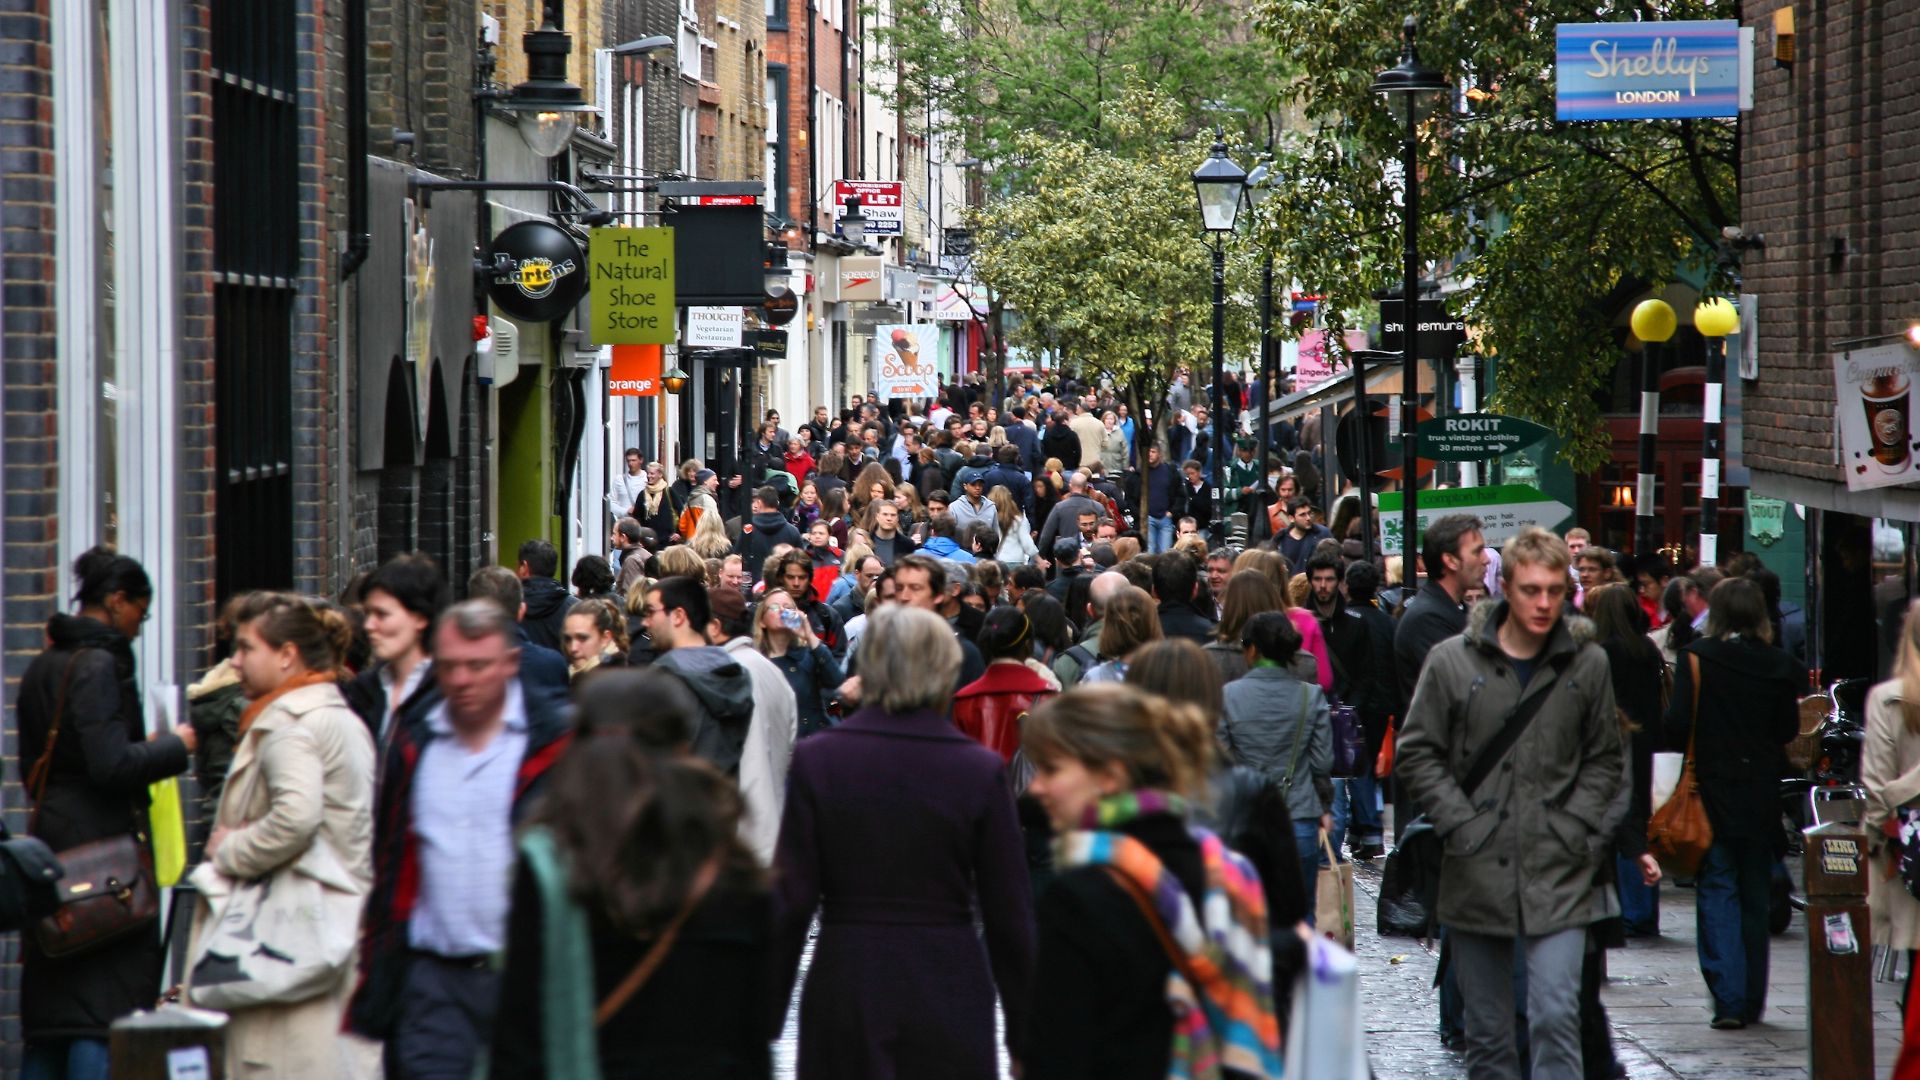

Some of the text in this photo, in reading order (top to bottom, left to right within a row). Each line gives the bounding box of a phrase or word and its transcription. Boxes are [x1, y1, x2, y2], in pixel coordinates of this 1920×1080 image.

[1586, 37, 1710, 97] Shellys
[1616, 90, 1680, 104] LONDON
[867, 194, 898, 204] LET
[863, 208, 898, 218] Shaw
[877, 221, 898, 229] 2255
[614, 236, 649, 257] The
[596, 258, 668, 281] Natural
[841, 269, 880, 280] speedo
[609, 285, 656, 307] Shoe
[608, 311, 658, 330] Store
[691, 312, 740, 322] THOUGHT
[696, 325, 734, 333] Vegetarian
[882, 353, 935, 386] Scoop
[609, 380, 652, 392] orange
[1445, 419, 1502, 432] ROKIT
[1428, 434, 1520, 443] true vintage clothing
[1439, 444, 1484, 452] 30 metres
[1423, 491, 1473, 506] compton
